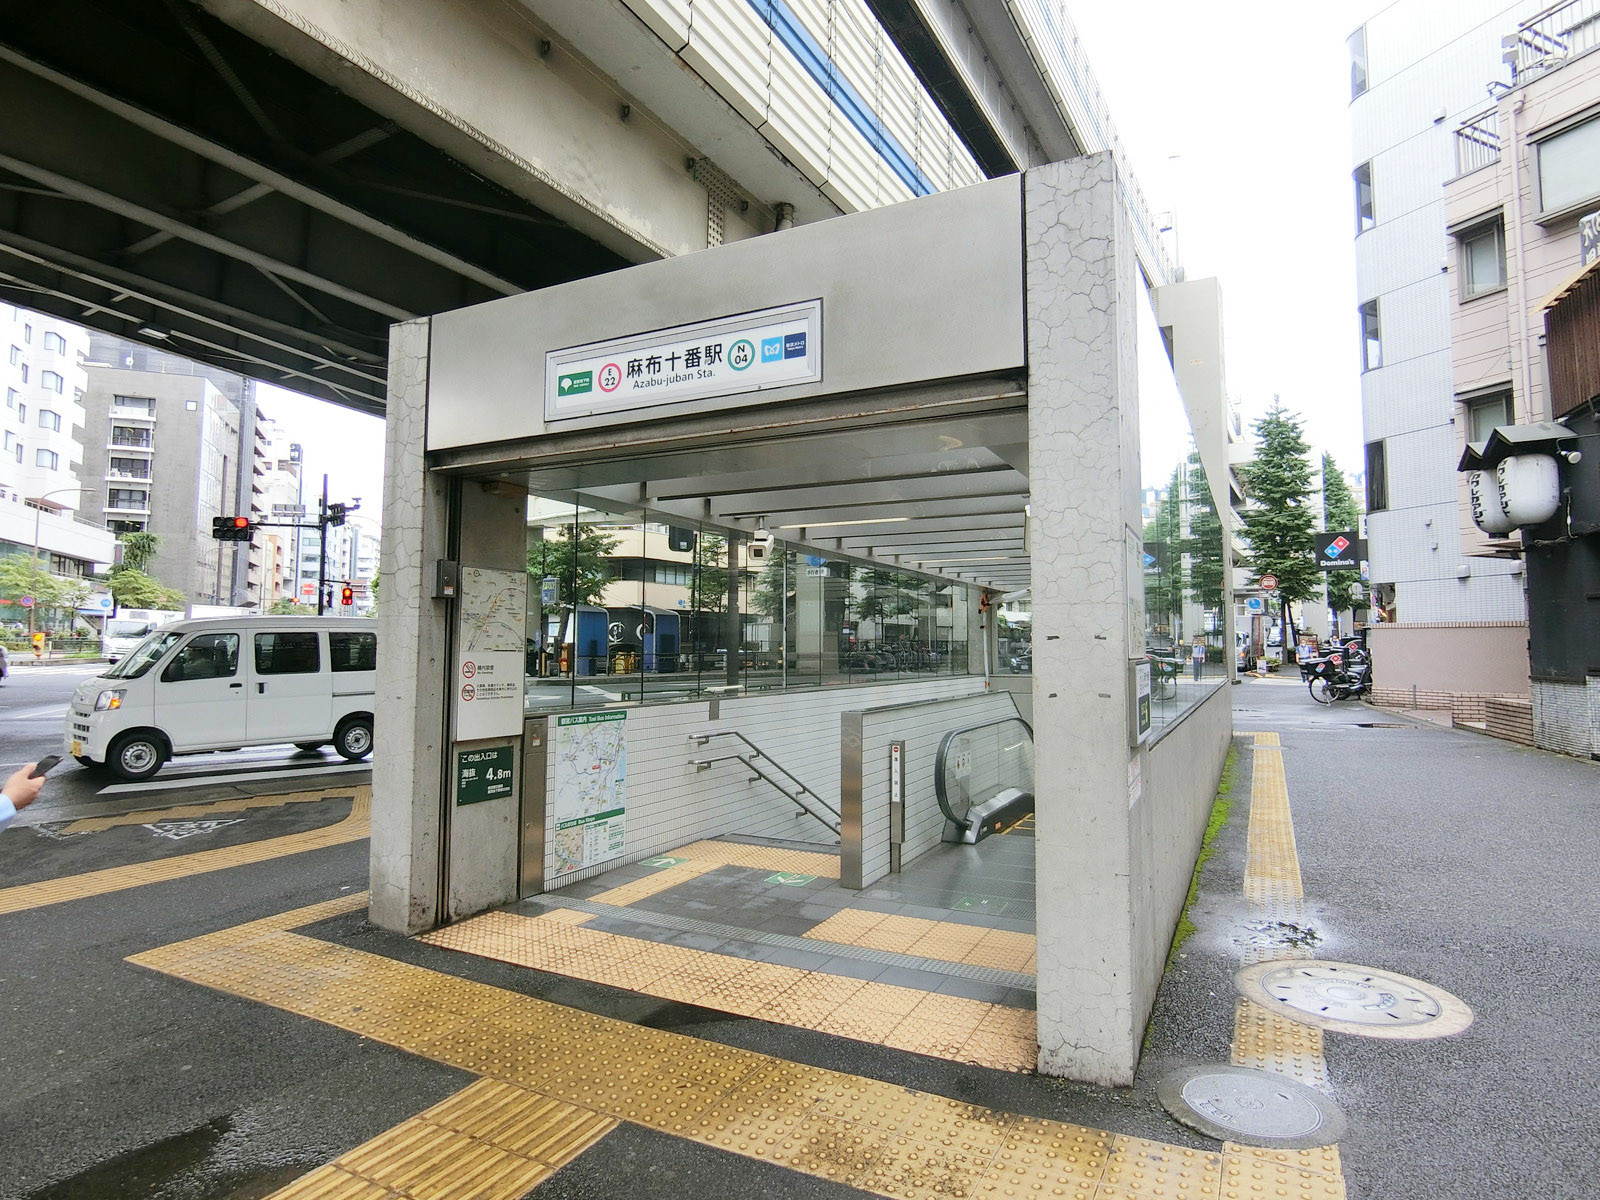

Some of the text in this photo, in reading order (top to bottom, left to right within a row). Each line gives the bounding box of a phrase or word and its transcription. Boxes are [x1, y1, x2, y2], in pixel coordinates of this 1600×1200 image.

[737, 344, 746, 354] N
[627, 343, 723, 379] 麻布十番駅
[734, 354, 748, 365] 04
[607, 368, 613, 377] E
[604, 377, 616, 387] 22
[632, 368, 716, 390] Azabu-juban Sta.
[1320, 559, 1354, 567] Domino's
[461, 751, 498, 763] この出入口は
[461, 768, 476, 778] 海抜
[486, 767, 511, 781] 4.8m
